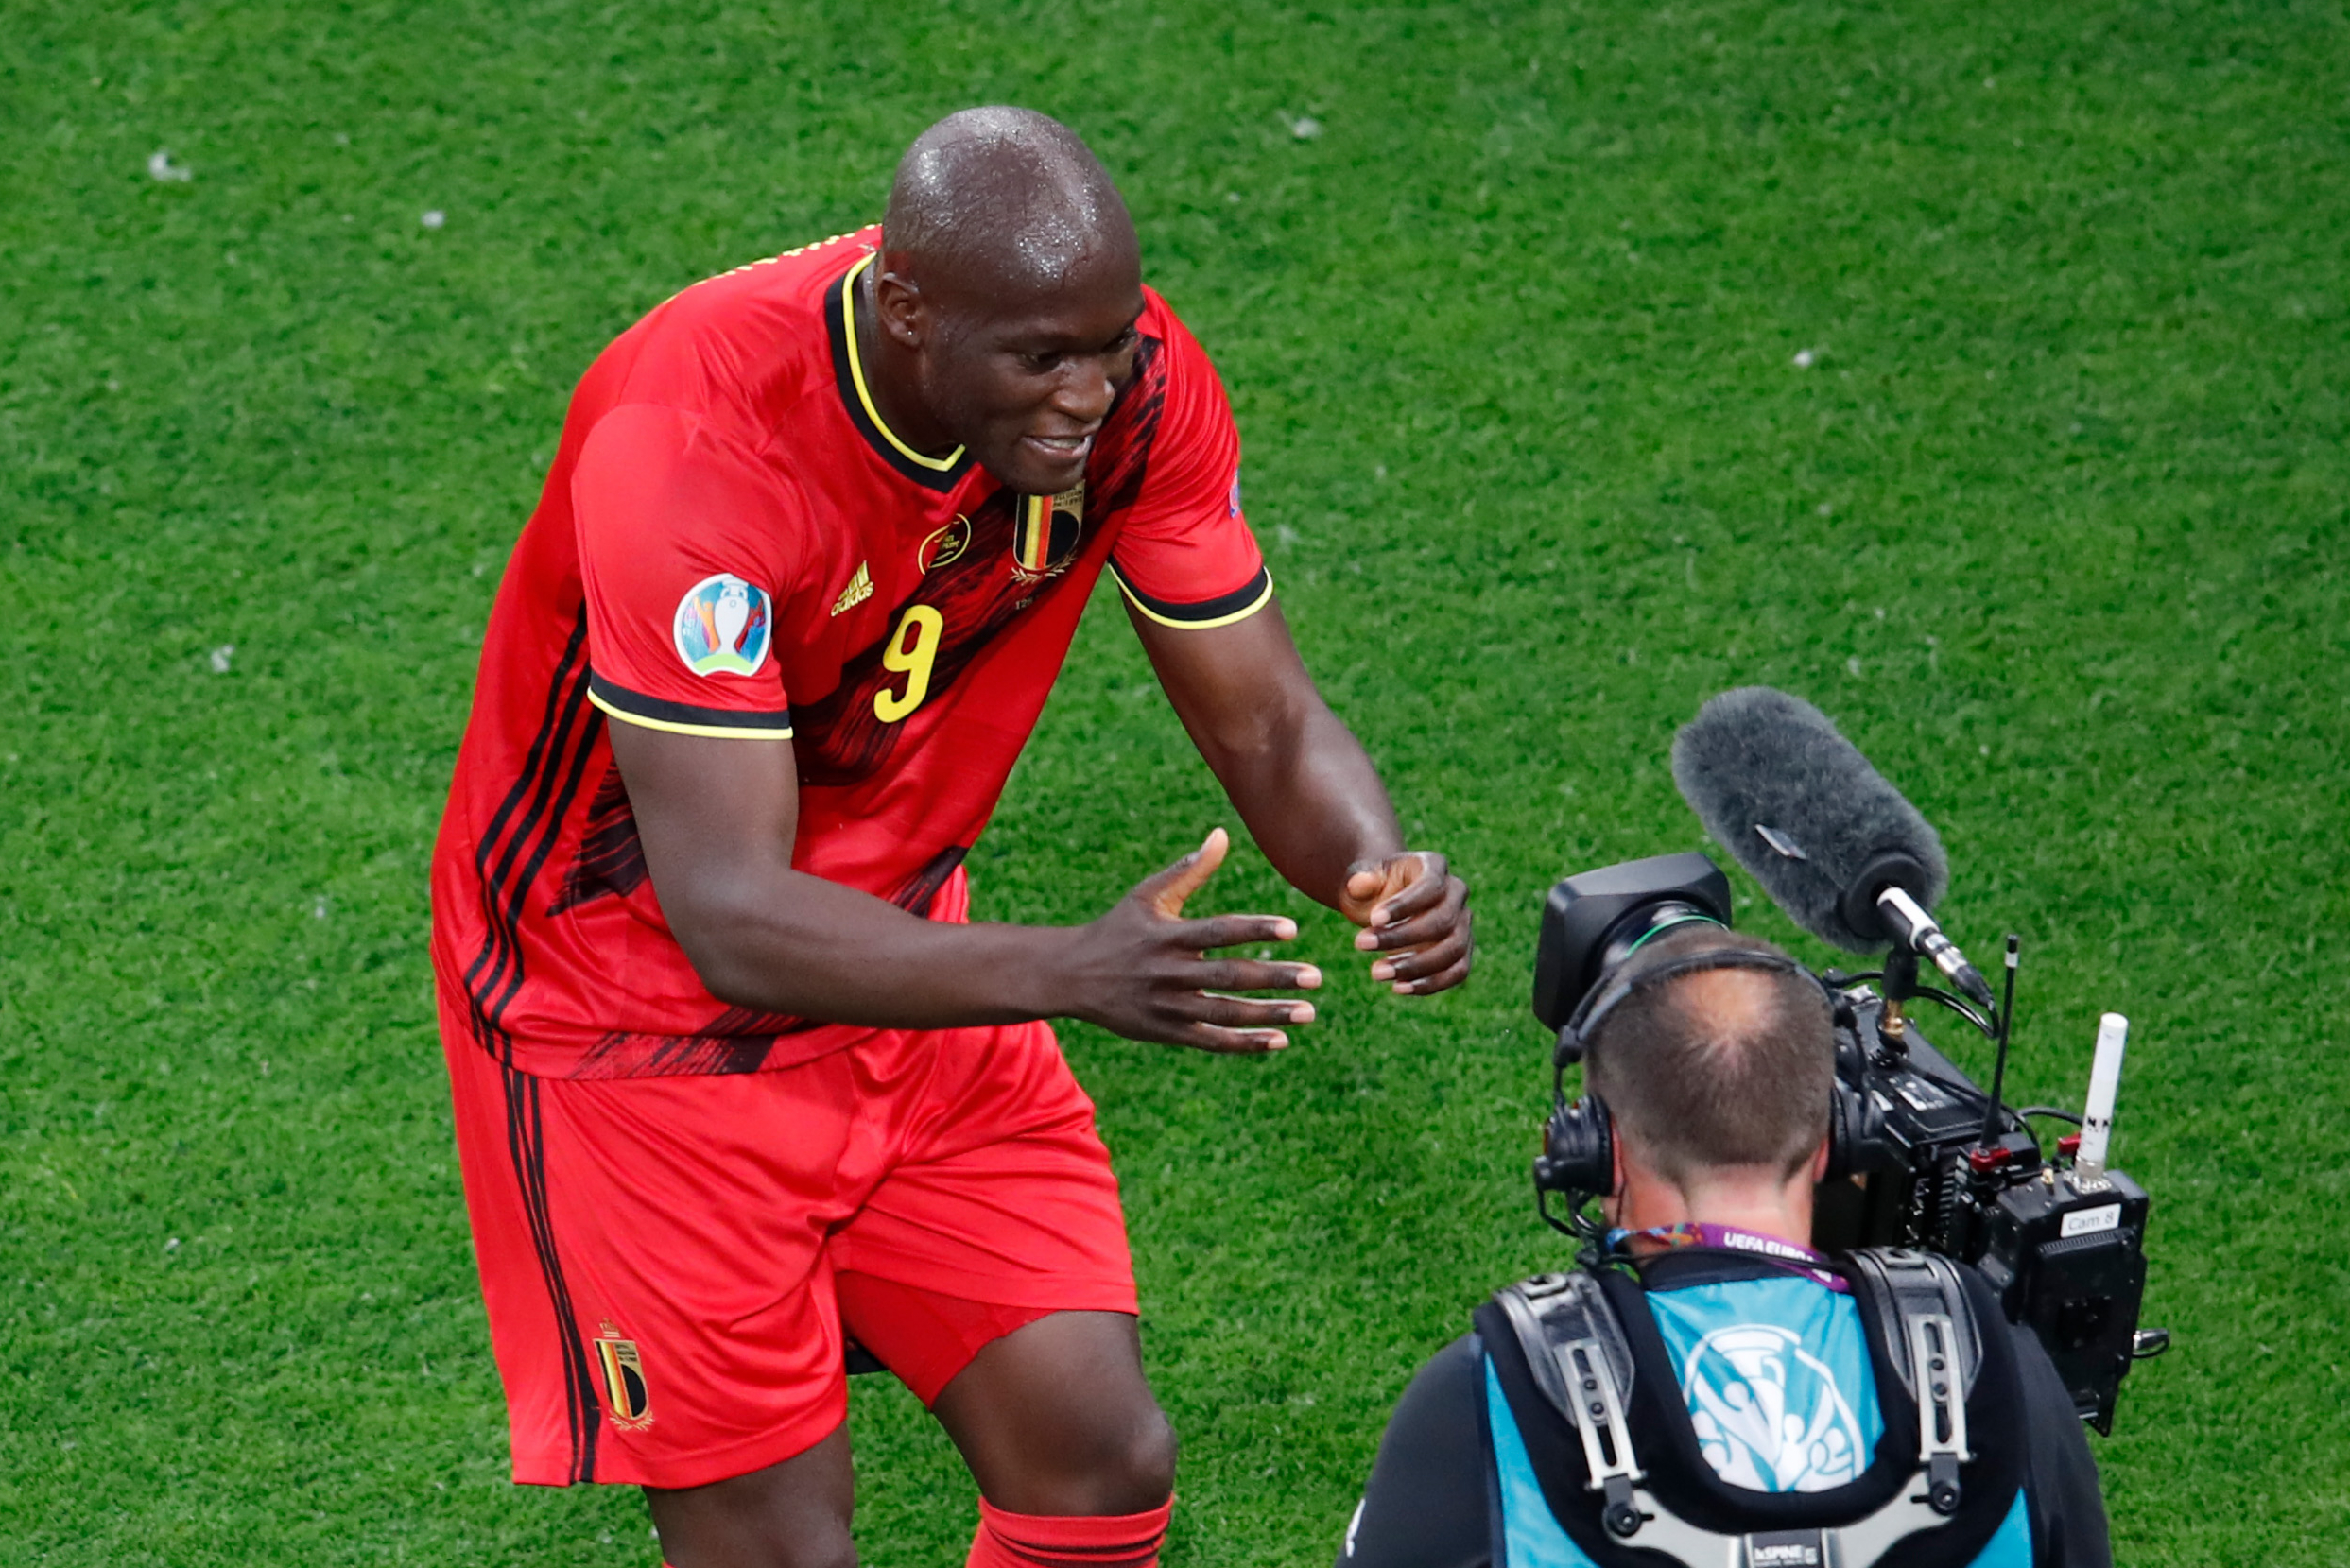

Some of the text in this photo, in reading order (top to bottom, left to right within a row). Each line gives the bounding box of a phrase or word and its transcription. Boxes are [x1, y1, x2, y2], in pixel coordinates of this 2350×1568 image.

[831, 581, 873, 616] adidas
[873, 605, 943, 723] 9
[2068, 1211, 2115, 1230] Cam 8
[1723, 1232, 1764, 1252] UEFA
